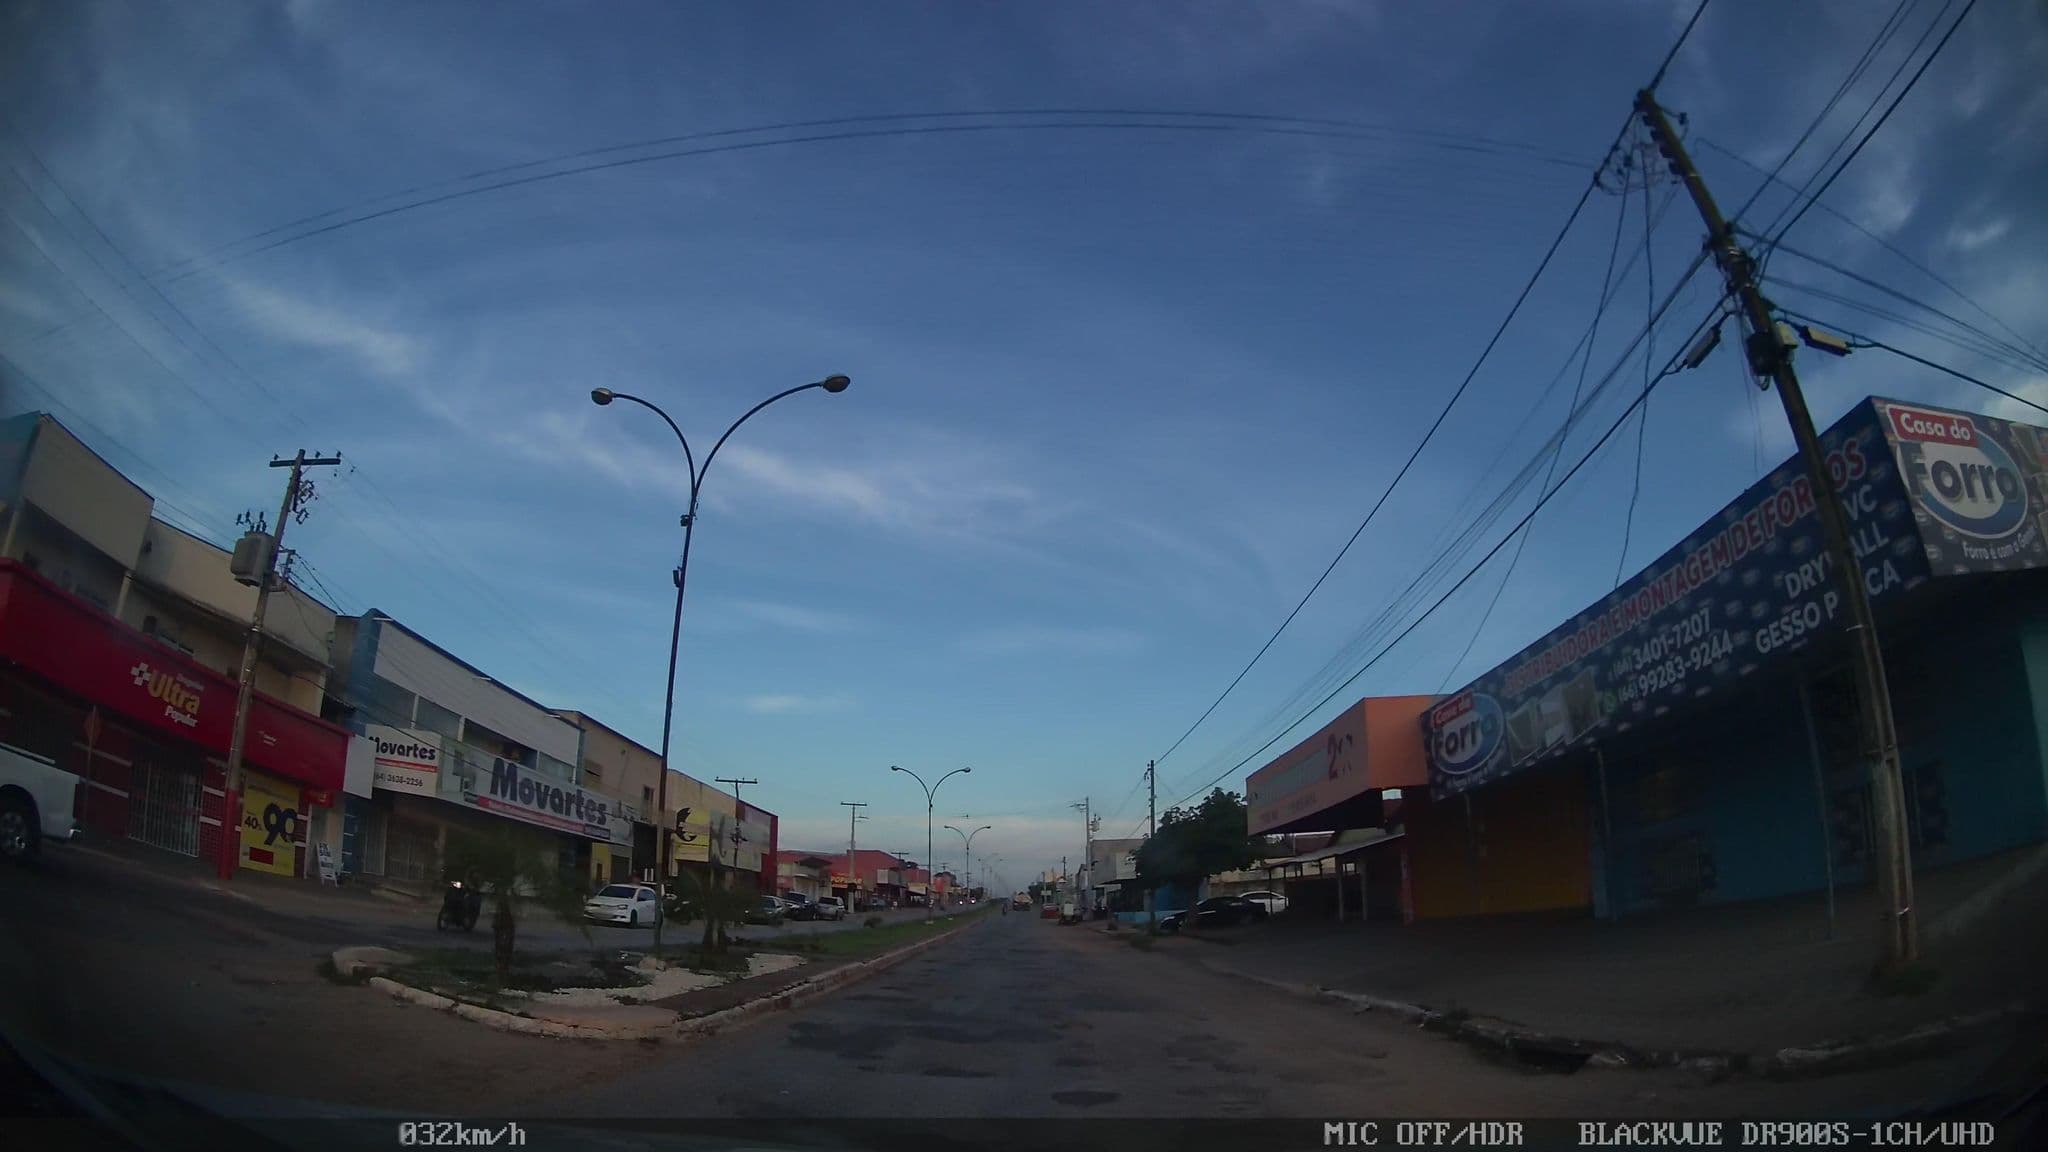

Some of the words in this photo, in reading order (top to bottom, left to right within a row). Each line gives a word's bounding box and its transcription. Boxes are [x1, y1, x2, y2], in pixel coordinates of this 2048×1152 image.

[1900, 412, 1946, 437] Casa
[1951, 419, 1971, 441] do
[1900, 441, 2018, 501] Forro
[1622, 529, 1733, 628] MONTAGEM
[1729, 507, 1764, 561] DE
[1759, 438, 1867, 540] FOROS
[1632, 606, 1711, 670] 3401-7207
[1756, 602, 1821, 654] GESSO
[147, 669, 200, 716] Ultra
[1638, 628, 1733, 697] 99283-9244
[489, 757, 608, 826] Movartes
